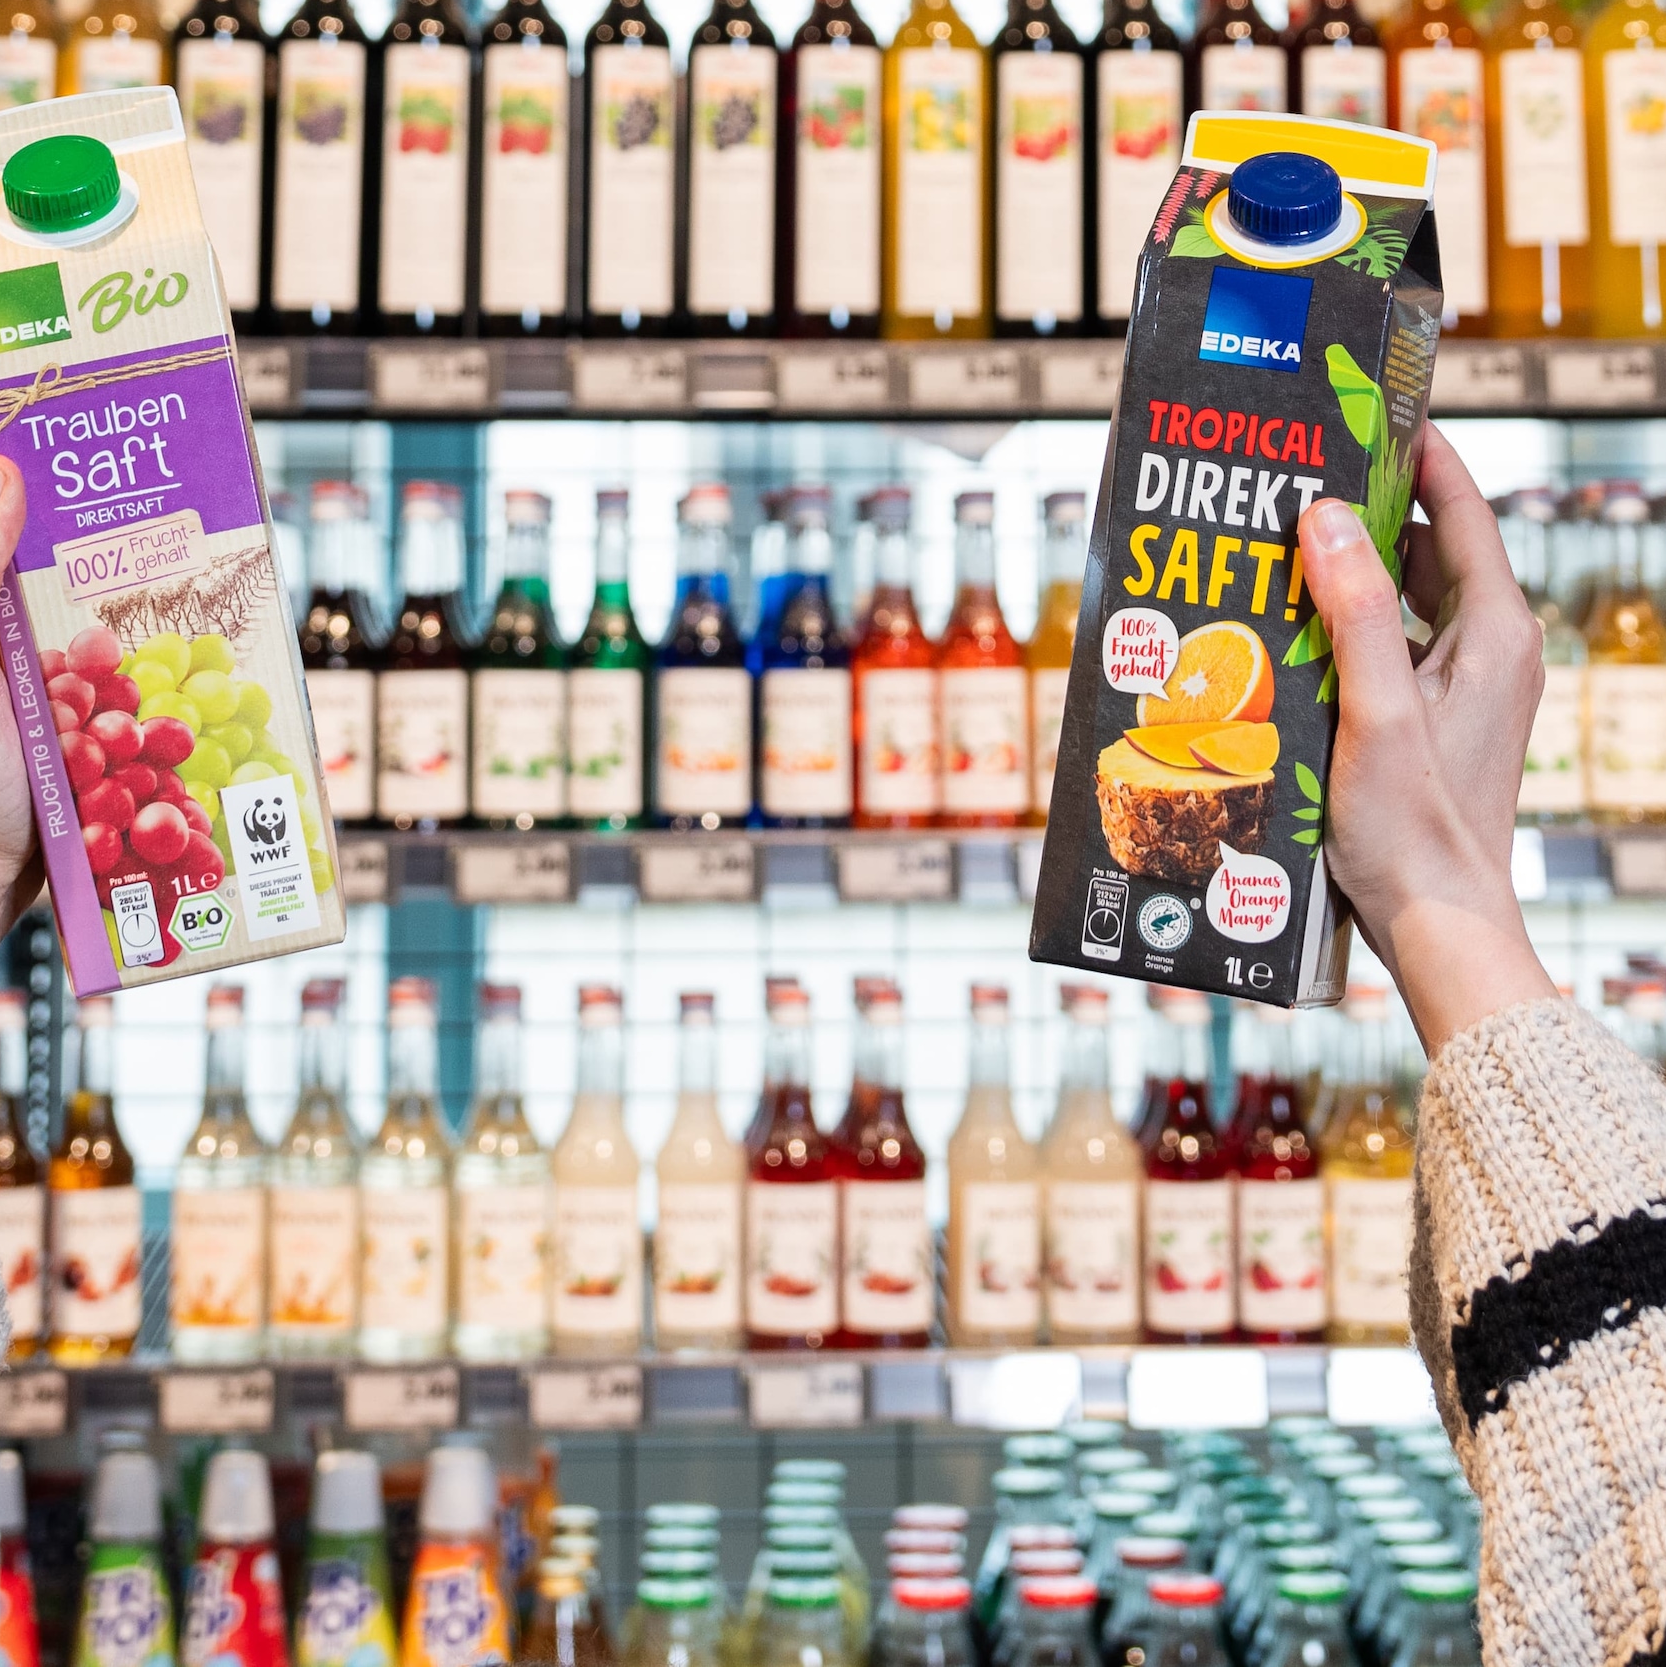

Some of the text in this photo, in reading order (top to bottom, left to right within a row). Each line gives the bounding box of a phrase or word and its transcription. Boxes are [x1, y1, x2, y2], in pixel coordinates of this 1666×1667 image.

[78, 268, 189, 334] Bio
[1200, 330, 1301, 363] EDEKA
[20, 392, 187, 450] Trauben
[1148, 399, 1326, 467] TROPICAL
[51, 432, 174, 499] Saft
[1135, 452, 1324, 534] DIREKT
[76, 496, 165, 528] DIREKTSAFT
[129, 524, 196, 554] Frucht-
[66, 546, 128, 588] 100%
[135, 544, 190, 580] gehalt
[1122, 523, 1304, 622] SAFT!
[4, 622, 22, 642] IN
[1121, 618, 1156, 636] 100%
[1112, 637, 1174, 659] Frucht-
[11, 646, 40, 721] LECKER
[1111, 657, 1168, 683] gehalt
[28, 724, 44, 738] &
[32, 743, 69, 838] FRUCHTIG
[250, 844, 291, 865] WWF
[109, 877, 123, 887] Pro
[250, 873, 302, 891] DIESES PRODUKT
[1093, 867, 1104, 877] Pro
[1219, 868, 1283, 891] Ananas
[282, 884, 296, 894] ZUM
[1229, 888, 1288, 912] Orange
[1218, 907, 1274, 932] Mango
[1145, 952, 1175, 964] Ananas
[1224, 956, 1243, 986] 1L
